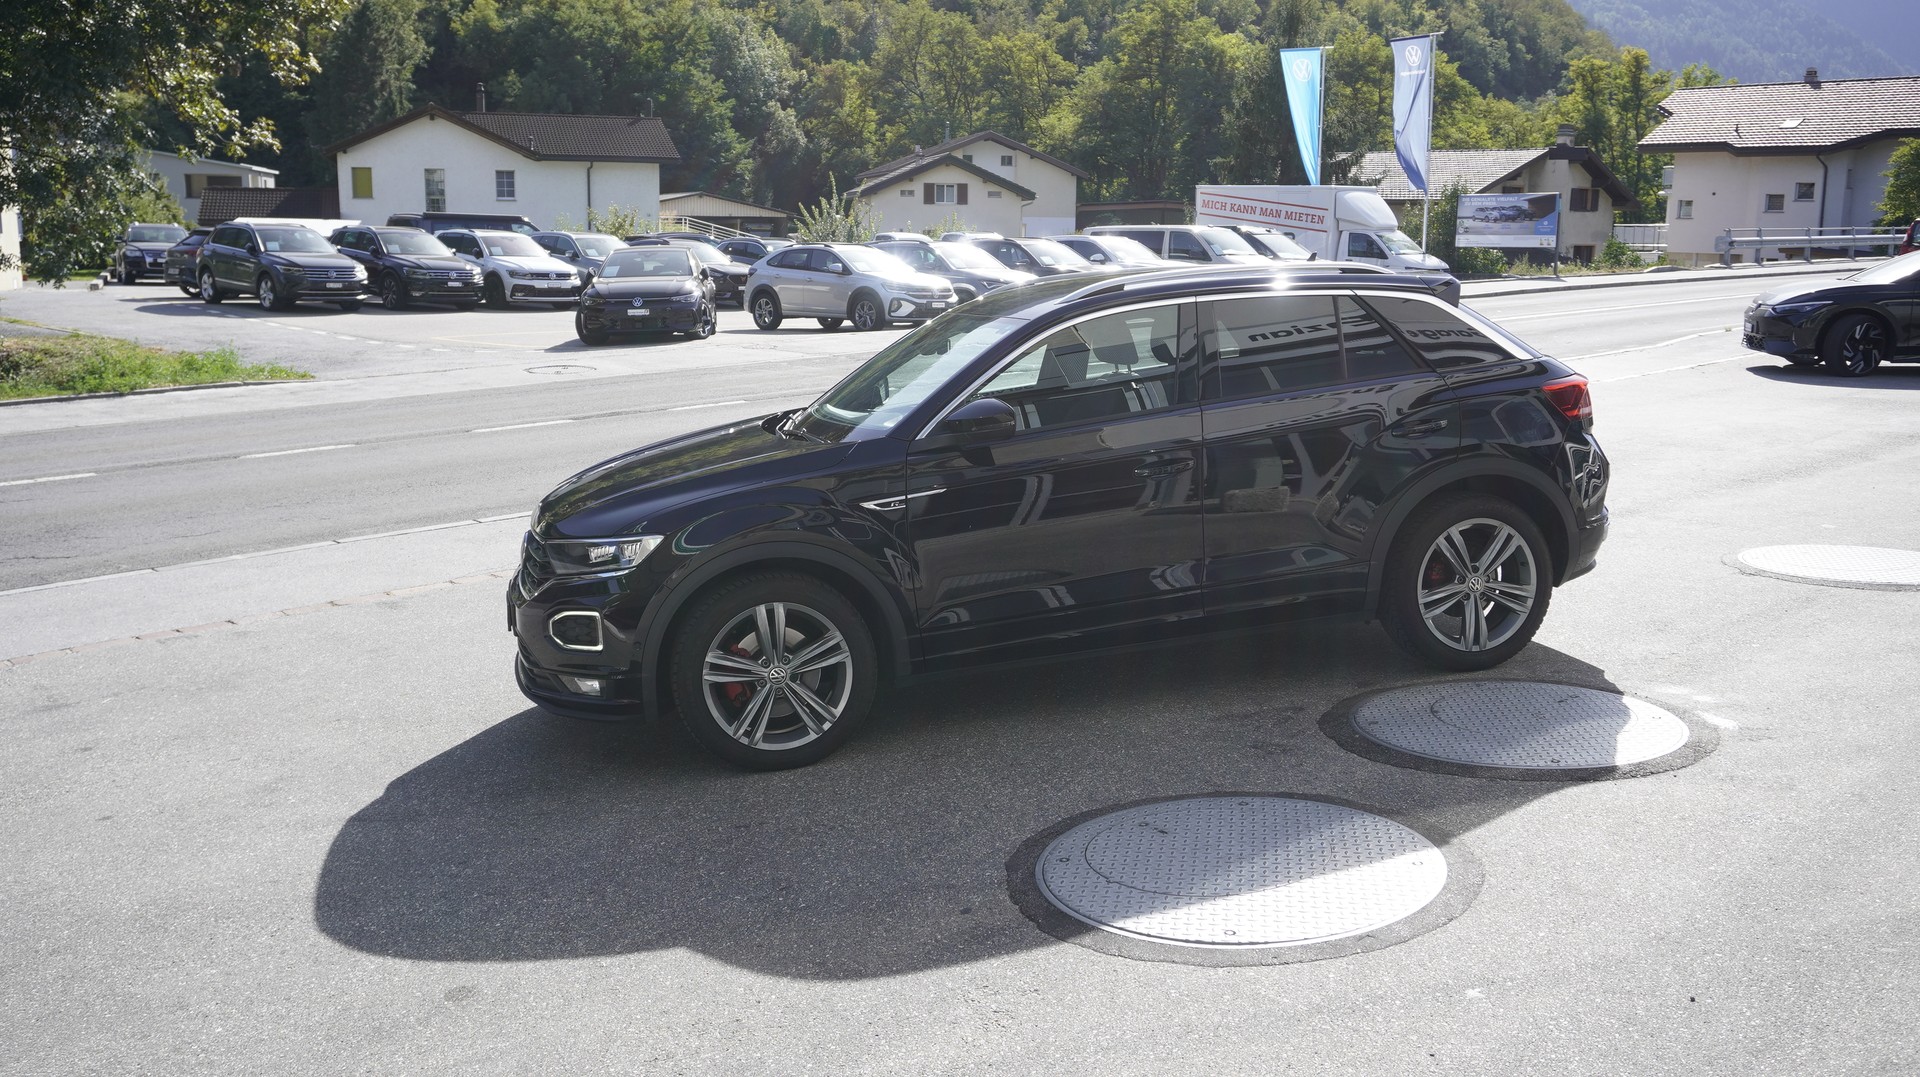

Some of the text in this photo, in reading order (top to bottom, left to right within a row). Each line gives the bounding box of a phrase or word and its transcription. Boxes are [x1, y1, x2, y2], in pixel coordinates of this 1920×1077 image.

[1201, 199, 1325, 225] MICH KANN MAN MIETEN
